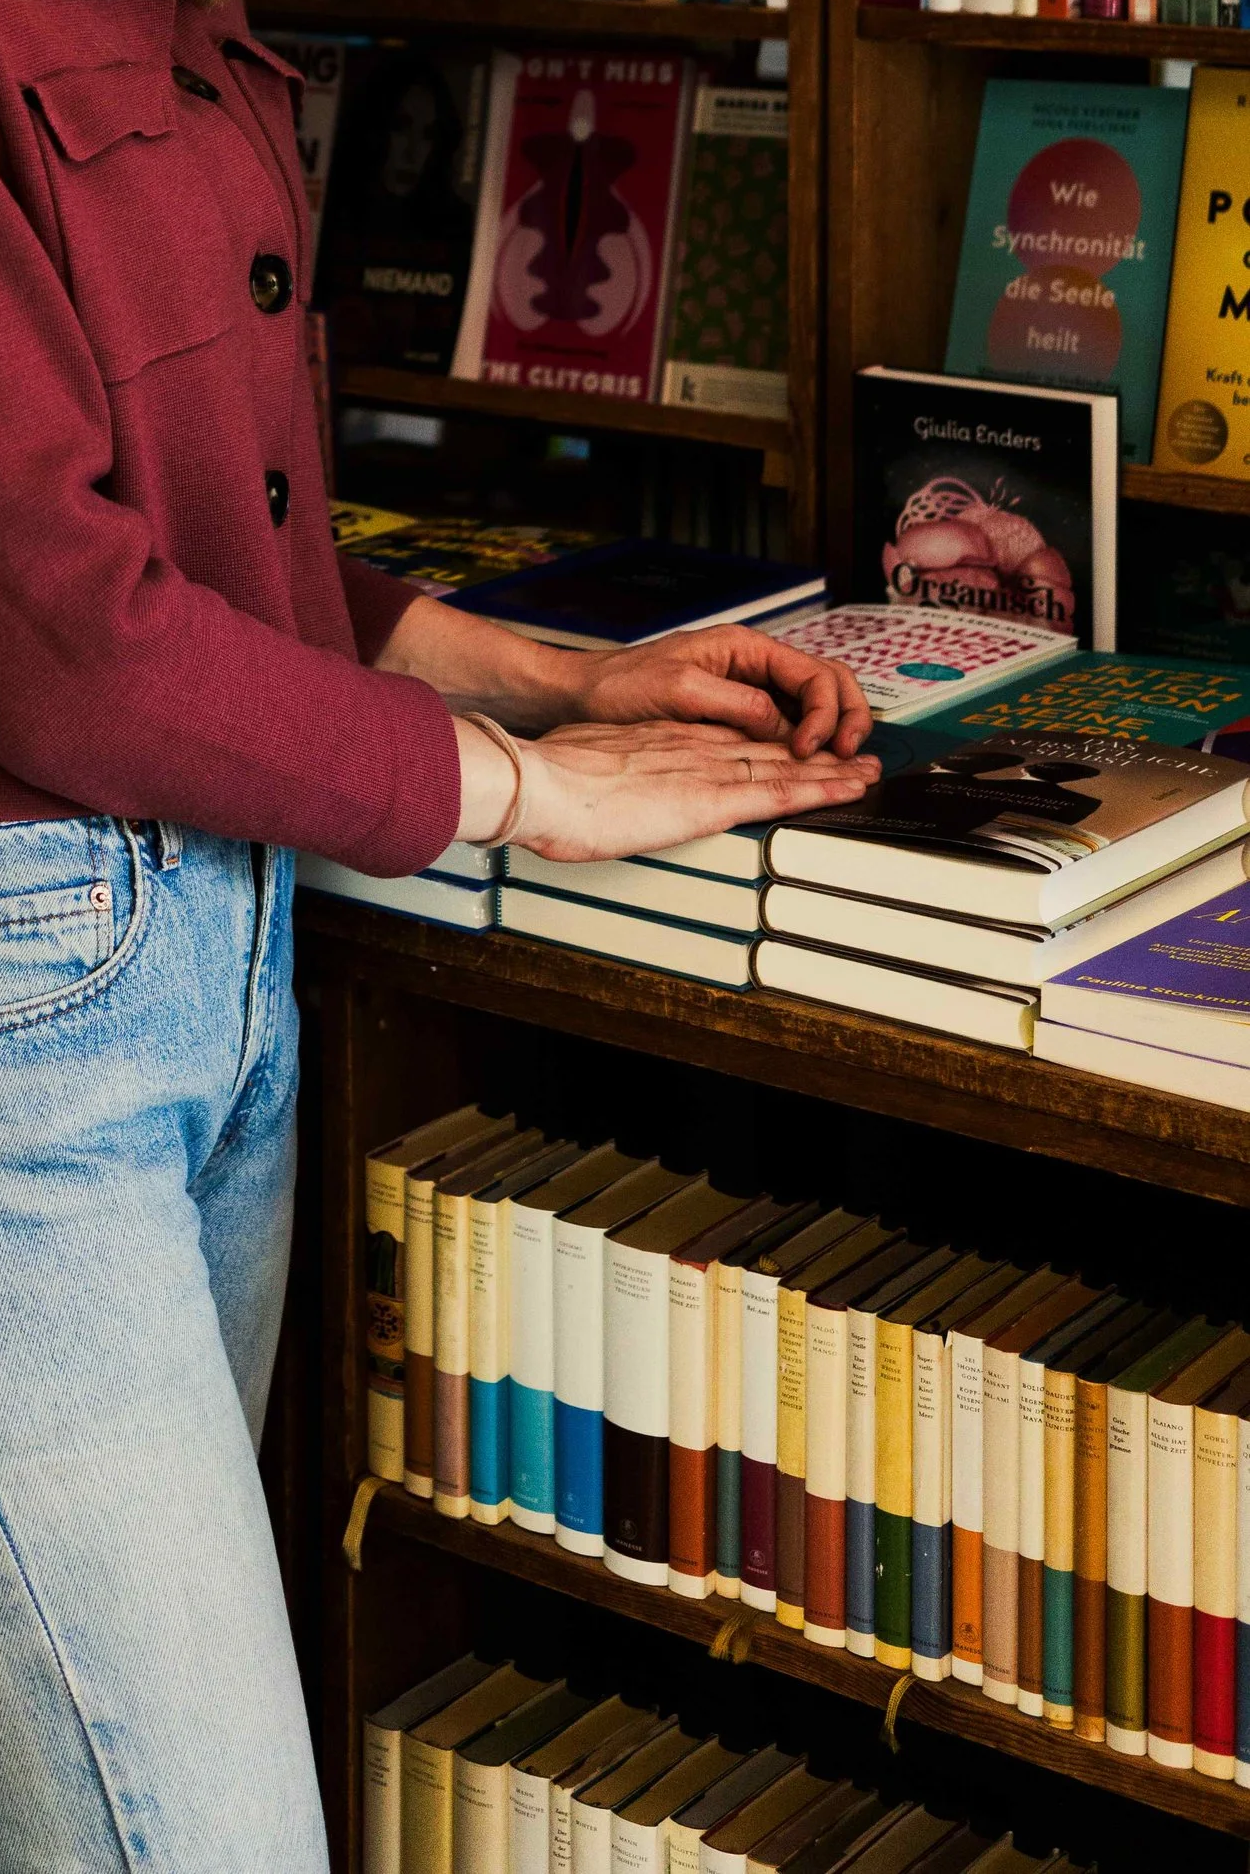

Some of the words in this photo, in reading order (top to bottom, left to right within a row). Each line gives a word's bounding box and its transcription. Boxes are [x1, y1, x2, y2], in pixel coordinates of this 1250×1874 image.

[1050, 181, 1099, 208] Wie
[992, 225, 1146, 261] Synchronität
[361, 265, 455, 298] NIEMAND
[1005, 275, 1042, 301] die
[1049, 277, 1117, 310] Seele
[1027, 325, 1080, 354] heilt
[526, 365, 643, 398] CLITORIS
[912, 415, 971, 443] Giulia
[975, 423, 1043, 454] Enders
[891, 562, 1068, 622] Organisch
[1075, 663, 1239, 687] JETZT
[1055, 672, 1145, 689] BIN
[1145, 680, 1244, 704] ICH
[1016, 692, 1123, 711] WIE
[1036, 683, 1221, 713] SCHON
[983, 702, 1155, 730] MEINE
[1082, 736, 1142, 753] DAS
[982, 737, 1220, 778] UNERSÄTTLICHE
[1032, 747, 1136, 767] SELBST
[1076, 975, 1149, 991] Pauline
[879, 1342, 903, 1352] JEWETT
[919, 1377, 932, 1386] Das
[960, 1373, 978, 1382] GON
[918, 1385, 934, 1394] Kind
[1045, 1389, 1075, 1401] DAUDET
[955, 1393, 984, 1405] KISSEN-
[918, 1410, 934, 1420] Meer
[959, 1403, 981, 1413] BUCH
[1022, 1414, 1043, 1424] MAYA
[1152, 1417, 1184, 1431] FLAIANO
[1045, 1422, 1076, 1433] LUNGEN
[1150, 1431, 1168, 1443] ALLES
[1170, 1437, 1187, 1446] HAT
[1203, 1433, 1229, 1445] GORKI
[1169, 1445, 1187, 1455] ZEIT
[1198, 1446, 1235, 1459] MEISTER-
[1196, 1455, 1238, 1468] NOVELLEN
[515, 1787, 535, 1799] MANN
[575, 1819, 598, 1832] WINTER
[619, 1836, 638, 1847] MANN
